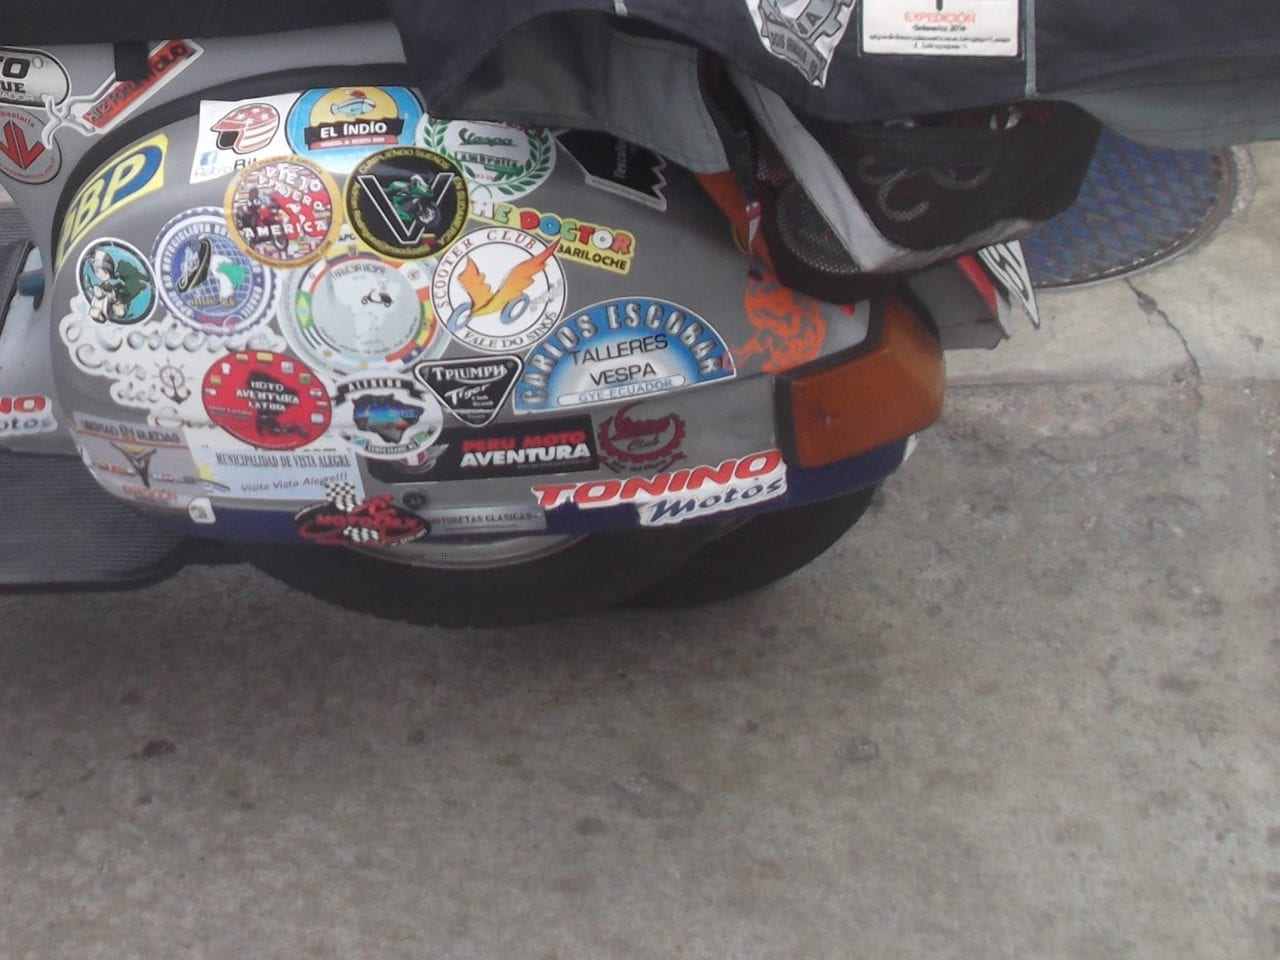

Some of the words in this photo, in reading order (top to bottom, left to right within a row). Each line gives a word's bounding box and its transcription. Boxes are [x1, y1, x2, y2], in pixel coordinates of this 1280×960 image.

[320, 126, 338, 139] EL
[458, 126, 516, 147] Vespa
[266, 162, 322, 193] VIEJO
[242, 220, 328, 240] AMERICA
[519, 210, 633, 256] DOCTOR
[435, 239, 475, 309] SCOOTER
[486, 229, 538, 251] CLUB
[463, 331, 498, 349] VALE
[502, 337, 525, 349] DO
[570, 333, 669, 367] TALLERES
[522, 313, 599, 405] CARLOS
[604, 302, 725, 376] ESCOBAR
[431, 363, 508, 383] TRIUMPH
[589, 362, 657, 388] VESPA
[235, 390, 300, 405] AVENTURA
[215, 452, 279, 468] MUNICIPALIDAD
[280, 455, 293, 468] DE
[293, 454, 318, 468] VISTA
[319, 454, 352, 468] ALEGRE
[460, 443, 592, 468] AVENTURA
[241, 481, 269, 493] Visite
[273, 478, 300, 490] Vista
[532, 450, 784, 507] TONINO
[649, 477, 784, 523] Motos
